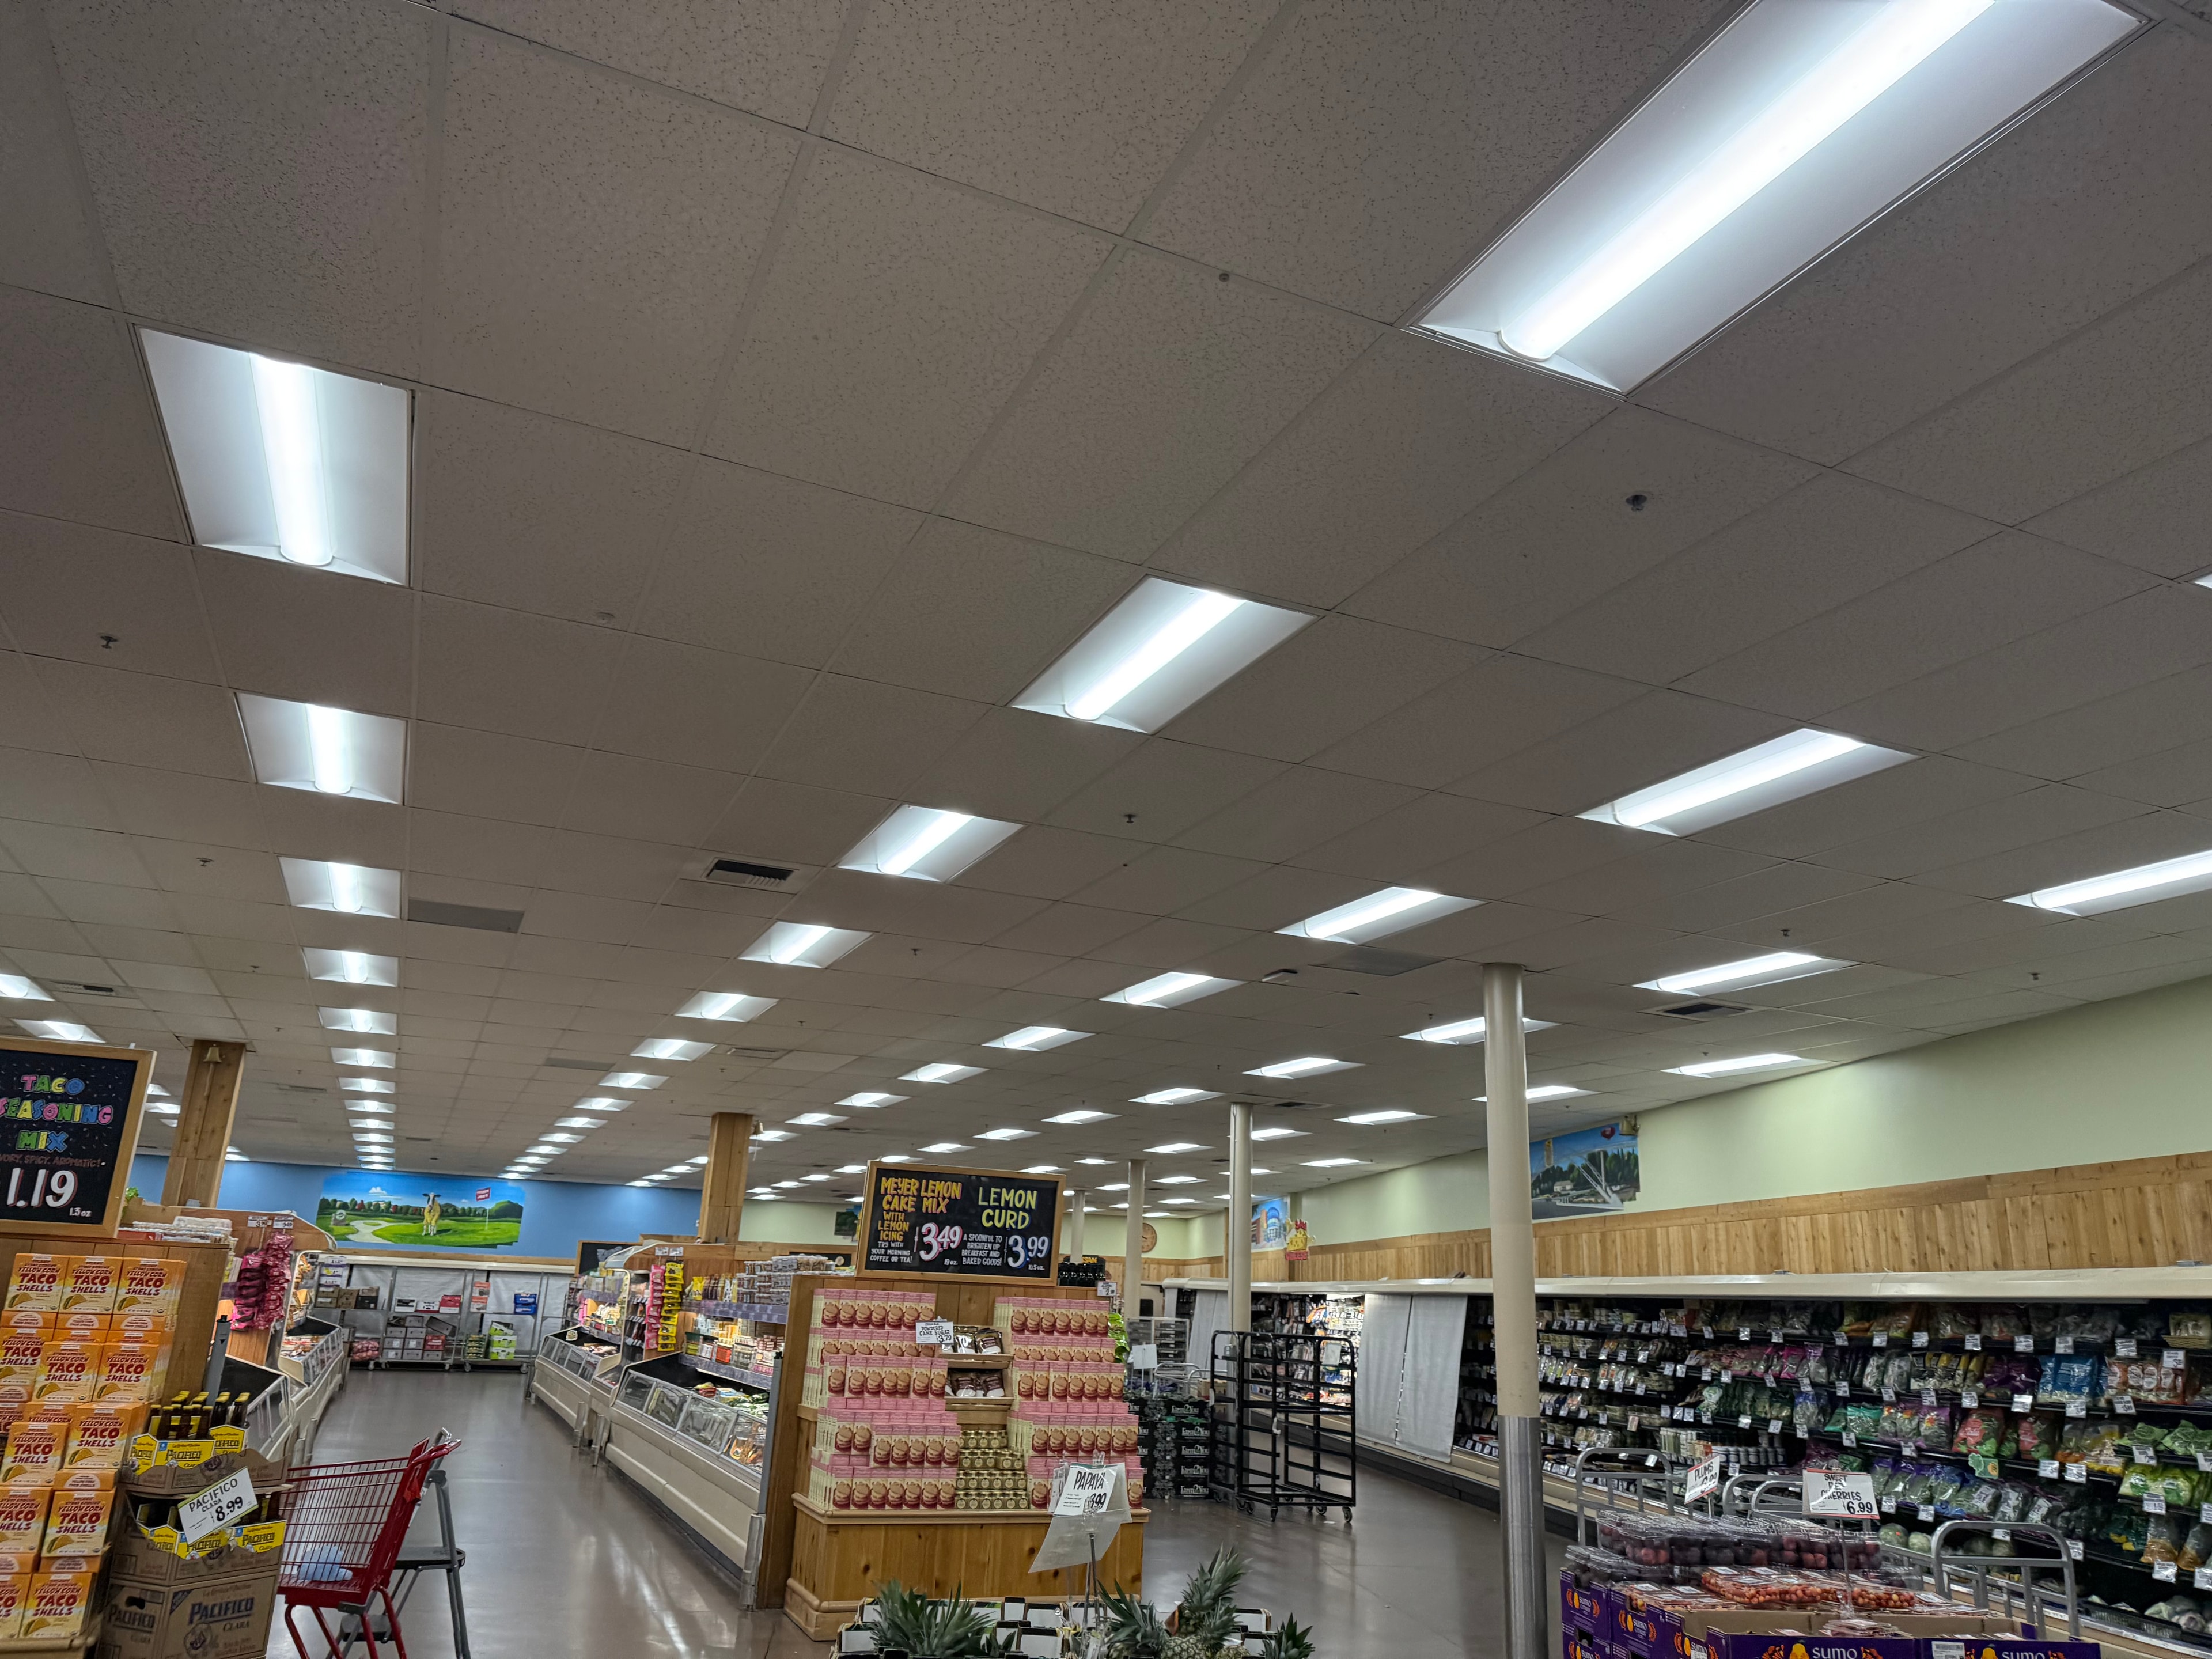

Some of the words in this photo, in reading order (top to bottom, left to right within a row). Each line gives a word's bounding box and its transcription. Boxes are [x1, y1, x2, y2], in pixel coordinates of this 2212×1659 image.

[21, 1074, 85, 1096] TACO
[0, 1097, 113, 1125] SEASONING
[16, 1130, 69, 1153] MIX
[7, 1168, 77, 1209] 1.19
[881, 1177, 920, 1196] MEYER
[921, 1179, 963, 1199] LEMON
[882, 1194, 917, 1212] CAKE
[922, 1197, 949, 1214] MIX
[978, 1187, 1037, 1209] LEMON
[883, 1211, 905, 1221] WITH
[982, 1209, 1030, 1229] CURD
[878, 1221, 910, 1232] LEMON
[880, 1232, 904, 1241] ICING
[919, 1222, 963, 1262] 3.49
[968, 1233, 994, 1242] SPOONFUL
[967, 1242, 992, 1250] BRIGHTEN
[1007, 1235, 1049, 1268] 3.99
[20, 1273, 57, 1285] TACO
[74, 1275, 110, 1286] TACO
[128, 1277, 164, 1288] TACO
[16, 1284, 53, 1292] SHELLS
[70, 1286, 107, 1294] SHELLS
[125, 1287, 161, 1296] SHELLS
[3, 1346, 41, 1357] TACO
[0, 1358, 37, 1366] SHELLS
[48, 1362, 86, 1374] TACO
[108, 1363, 145, 1374] TACO
[44, 1374, 82, 1382] SHELLS
[105, 1374, 141, 1382] SHELLS
[80, 1427, 120, 1439] TACO
[14, 1444, 53, 1455] TACO
[11, 1456, 49, 1464] SHELLS
[1695, 1461, 1714, 1482] PLUMS
[1073, 1471, 1105, 1490] PAPAYA
[189, 1478, 238, 1512] PACIFICO
[202, 1498, 223, 1512] CLARA
[215, 1496, 243, 1522] 8.99
[59, 1512, 101, 1525] TACO
[0, 1522, 32, 1531] HELLS
[56, 1525, 96, 1533] SHELLS
[36, 1594, 78, 1607] TACO
[32, 1607, 74, 1616] SHELLS
[109, 1604, 155, 1630] PACIFICO
[188, 1597, 255, 1625] PACIFICO
[1813, 1646, 1858, 1659] sumo
